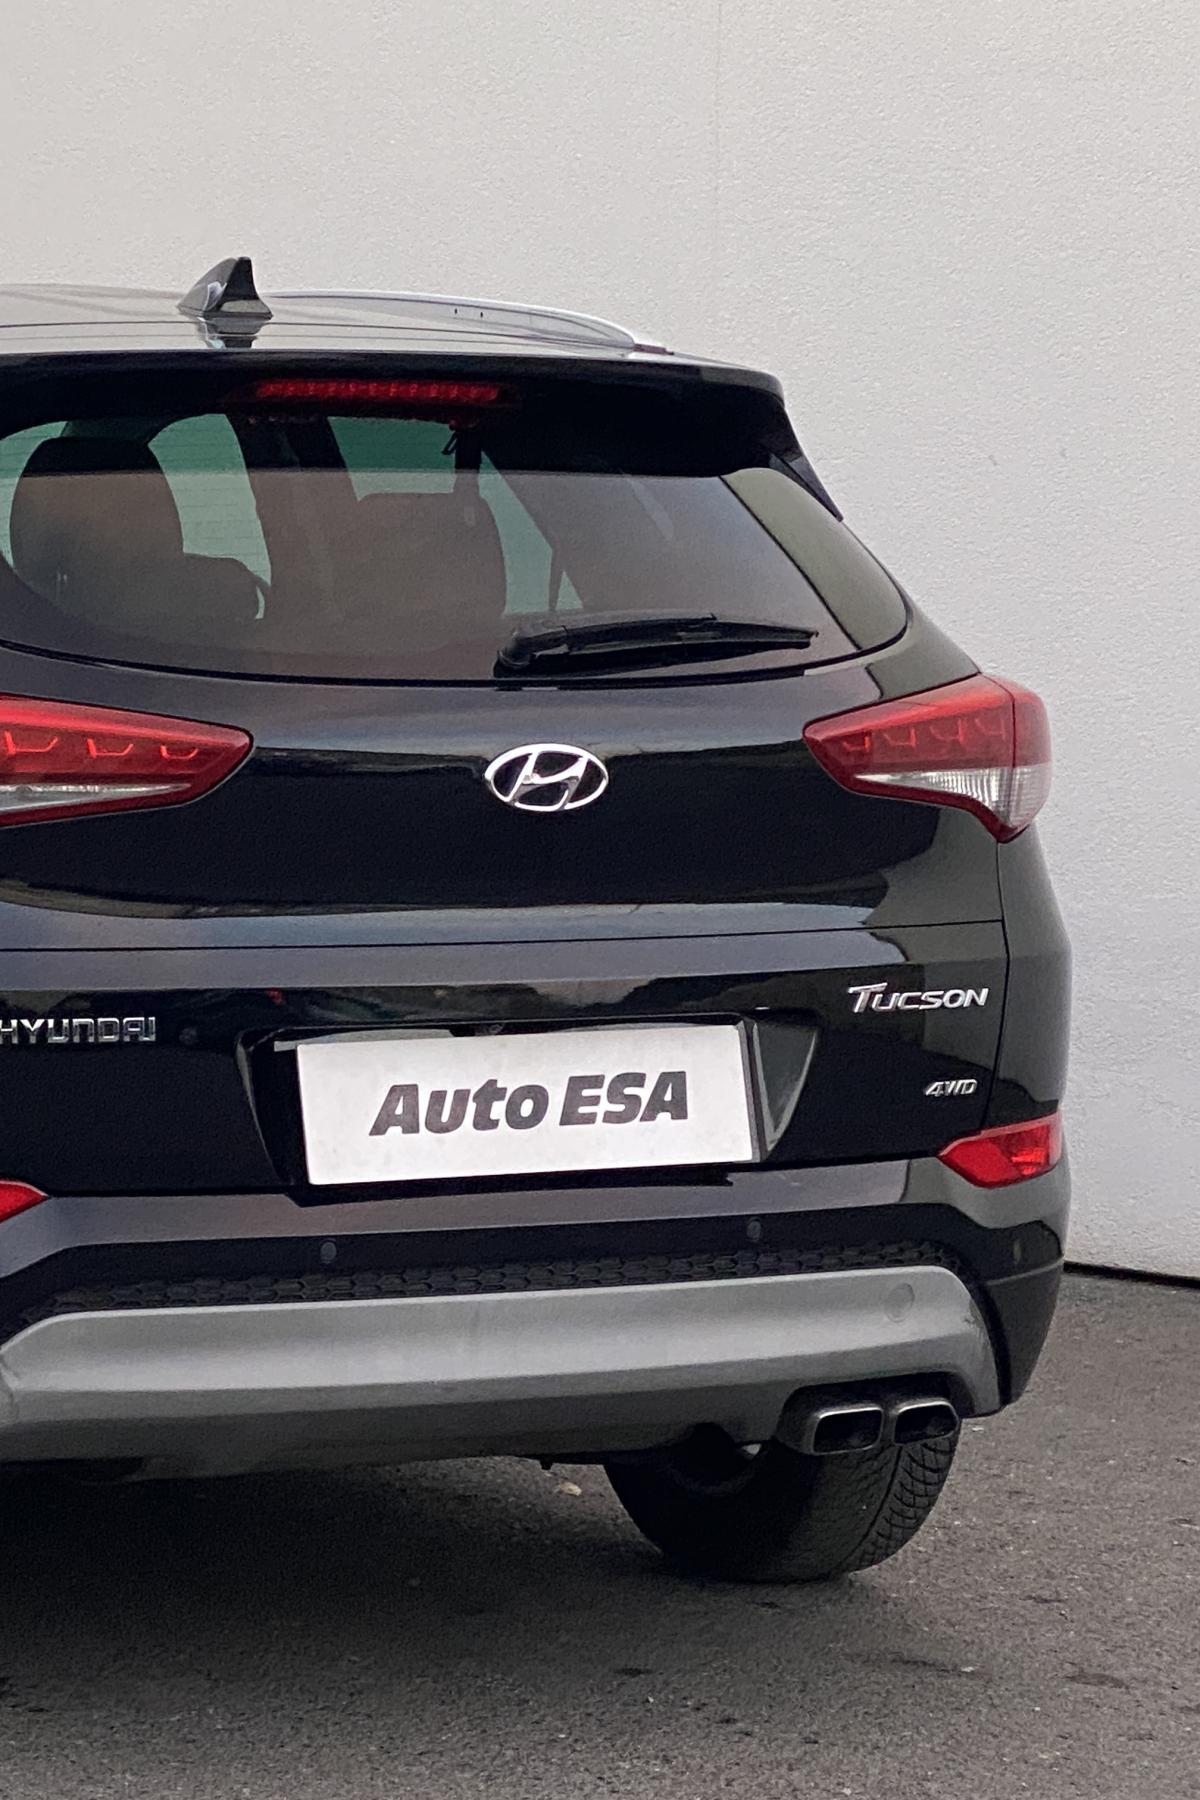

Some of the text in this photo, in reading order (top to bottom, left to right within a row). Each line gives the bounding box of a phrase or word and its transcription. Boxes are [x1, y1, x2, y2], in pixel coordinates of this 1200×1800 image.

[848, 982, 989, 1013] TUCSON
[924, 1078, 978, 1097] 4WD
[369, 1071, 688, 1136] Auto ESA
